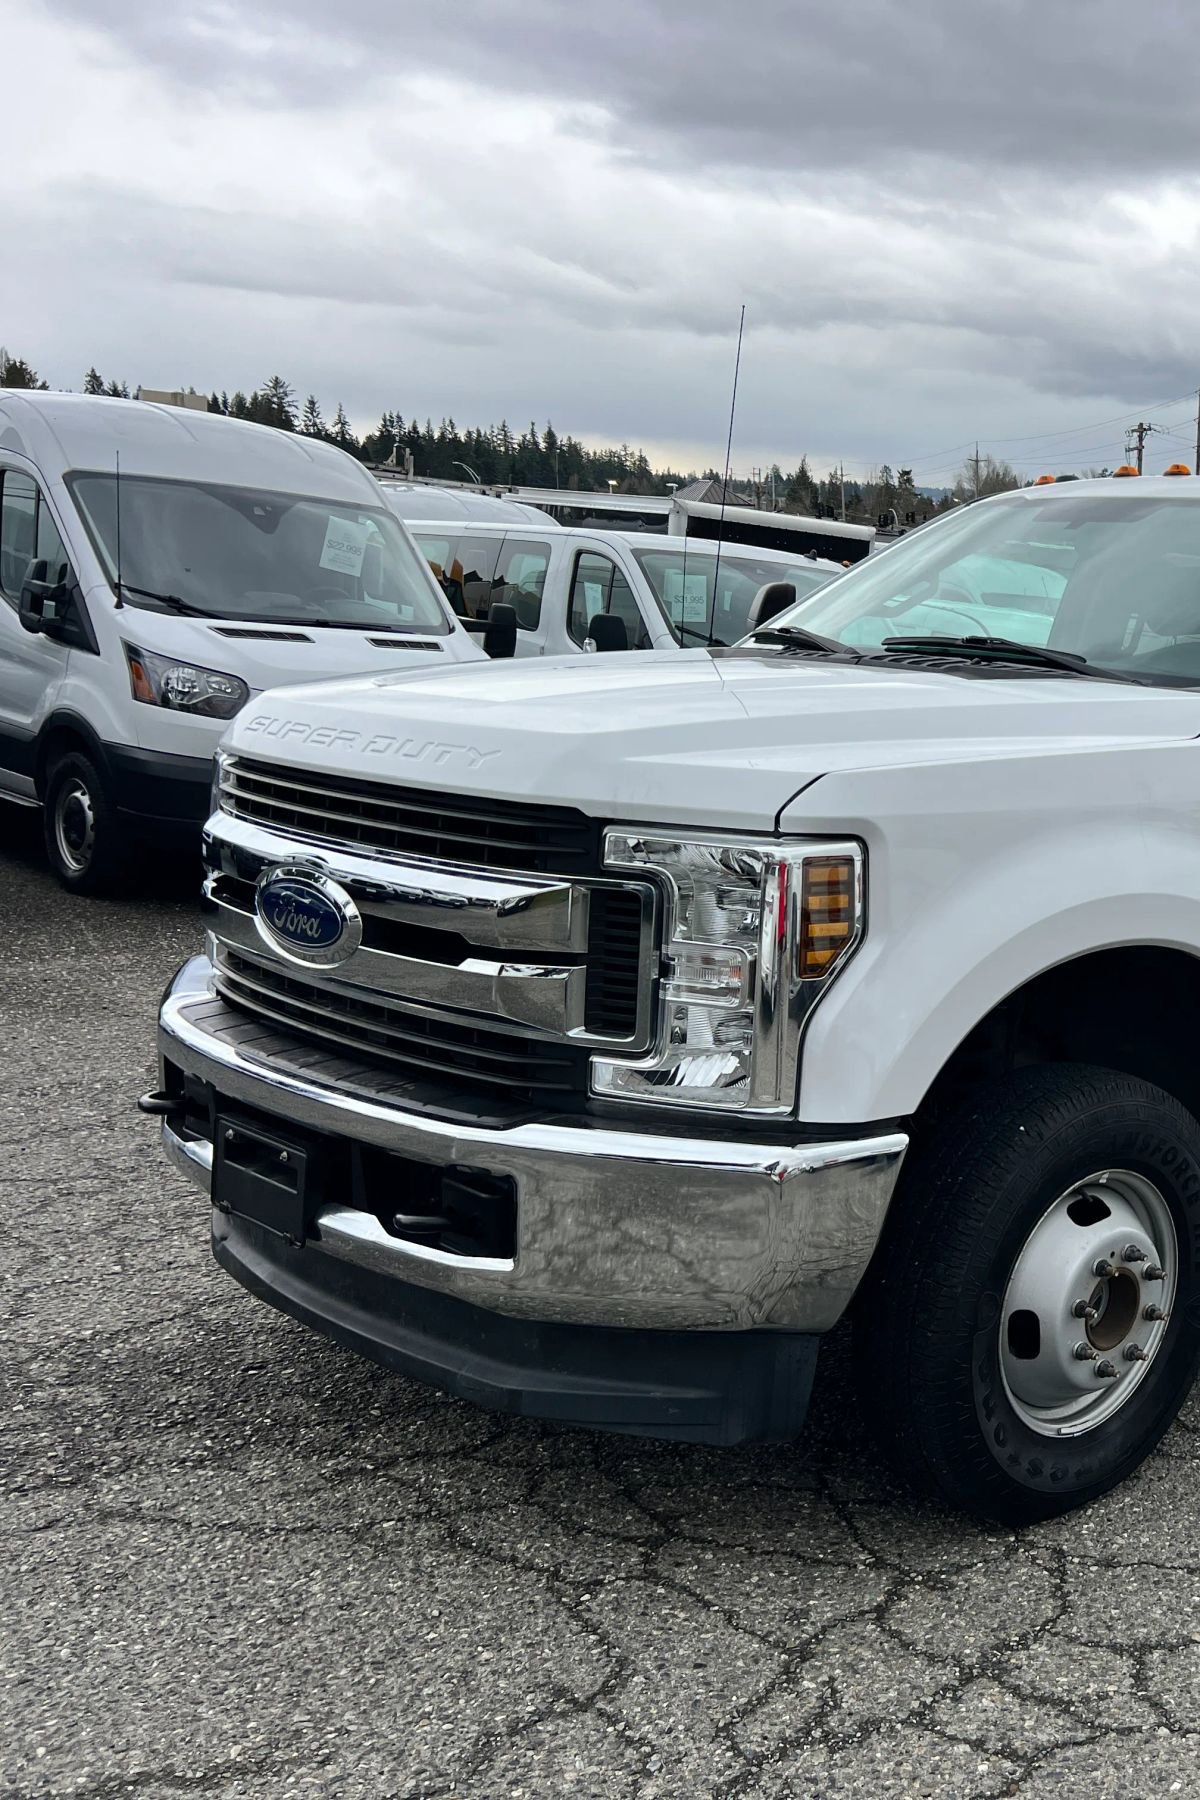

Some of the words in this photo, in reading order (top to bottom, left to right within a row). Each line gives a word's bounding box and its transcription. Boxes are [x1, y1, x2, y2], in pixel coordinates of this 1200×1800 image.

[244, 715, 361, 748] SUPER
[361, 734, 502, 769] DUTY
[272, 890, 322, 939] Ford
